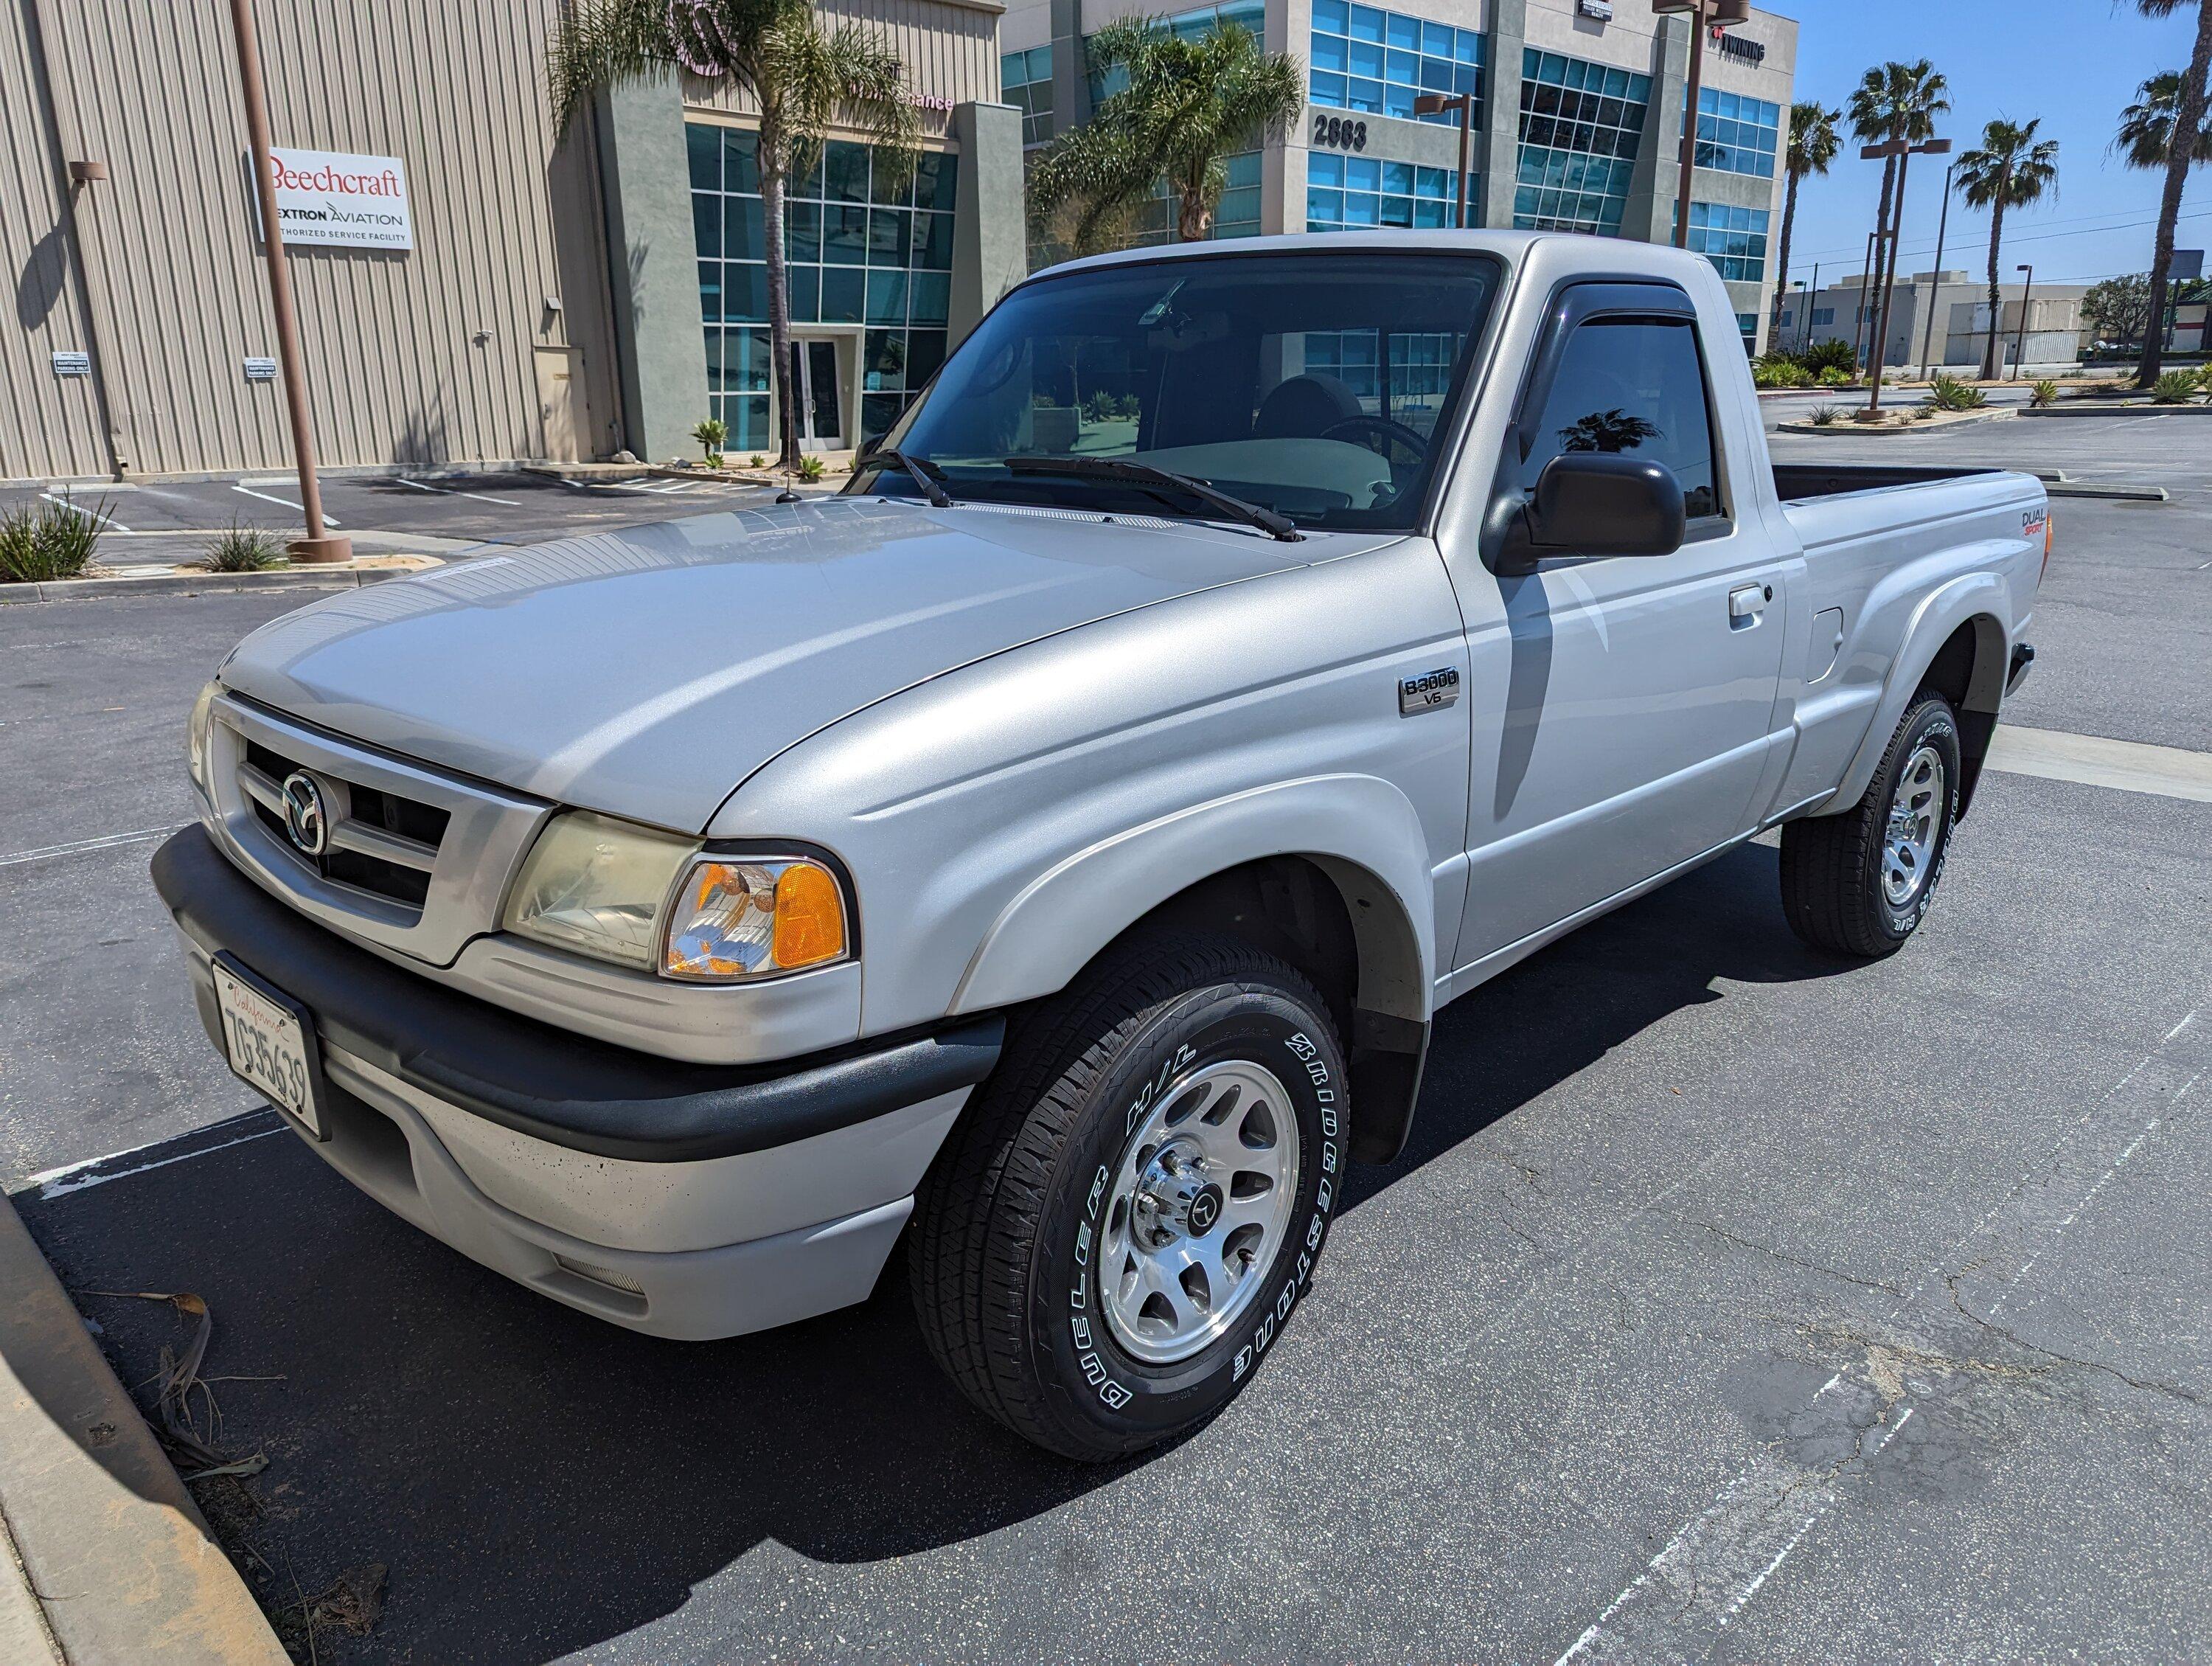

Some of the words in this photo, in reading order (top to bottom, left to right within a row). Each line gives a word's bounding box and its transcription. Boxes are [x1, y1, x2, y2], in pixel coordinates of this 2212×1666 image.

[1722, 32, 1765, 61] TWINING
[1313, 114, 1367, 149] 2883
[276, 207, 327, 222] EXTRON
[331, 206, 403, 226] AVIATION
[280, 228, 326, 237] THORIZED
[329, 232, 366, 240] SERVICE
[369, 233, 406, 242] FACILITY
[2022, 508, 2047, 527] DUAL
[2025, 522, 2044, 536] SPORT
[1404, 669, 1459, 695] B3000
[1424, 692, 1442, 705] V6
[232, 985, 290, 1043] California
[1232, 1032, 1338, 1383] BRIDGESTONE
[1070, 1163, 1134, 1409] DUELER
